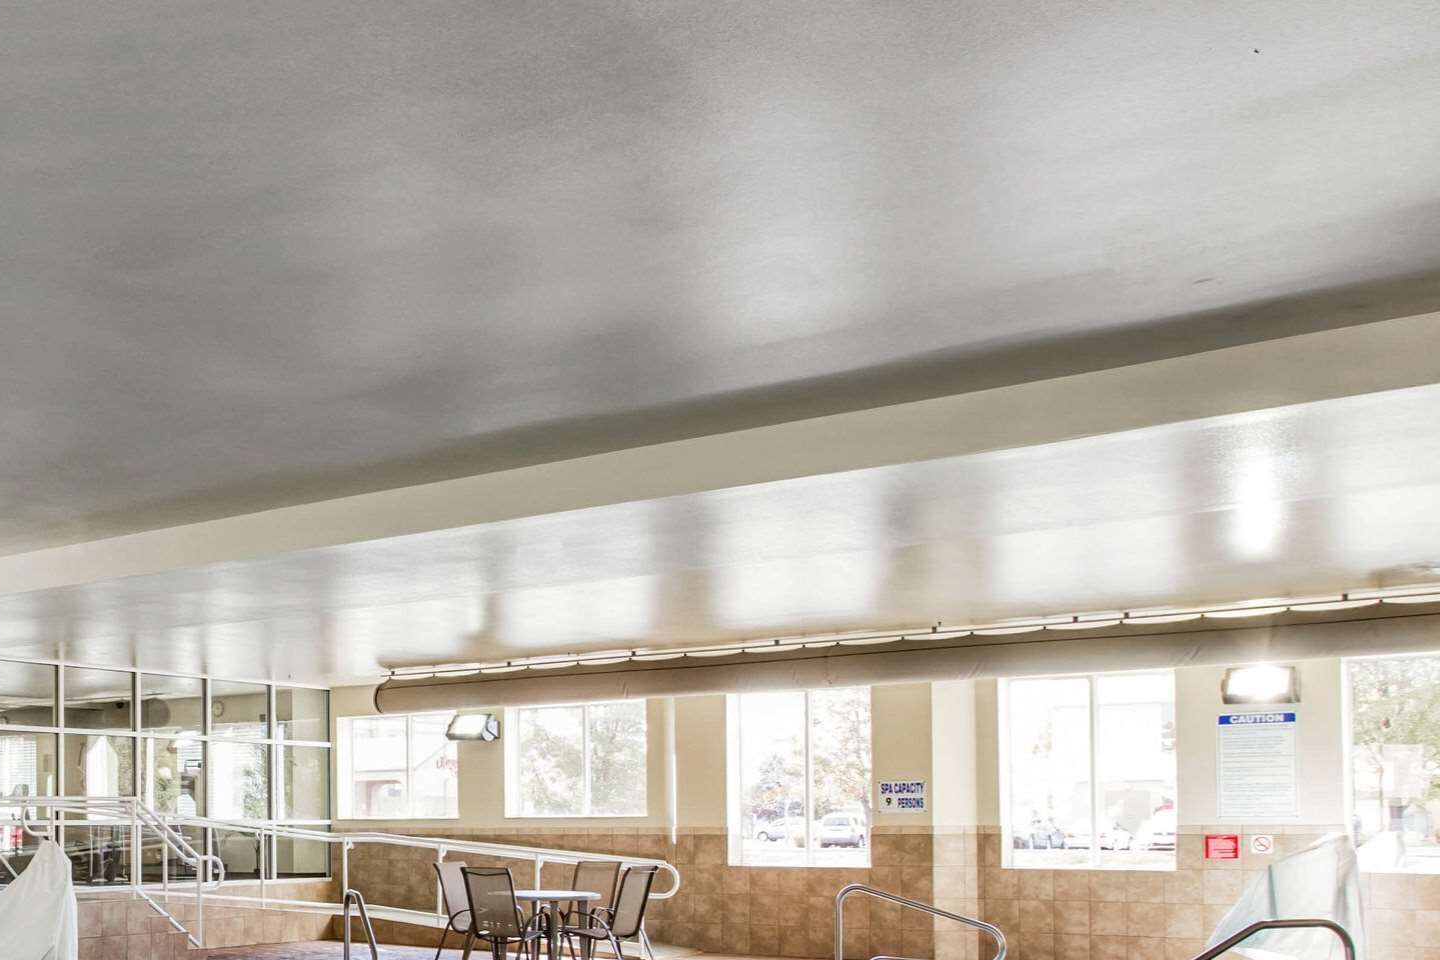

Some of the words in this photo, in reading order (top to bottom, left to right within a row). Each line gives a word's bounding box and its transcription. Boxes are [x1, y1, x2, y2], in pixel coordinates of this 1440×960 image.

[1229, 714, 1285, 724] CAUTION
[880, 783, 893, 794] SPA
[894, 782, 924, 794] CAPACITY
[885, 797, 892, 806] 9
[897, 797, 924, 809] PERSONS
